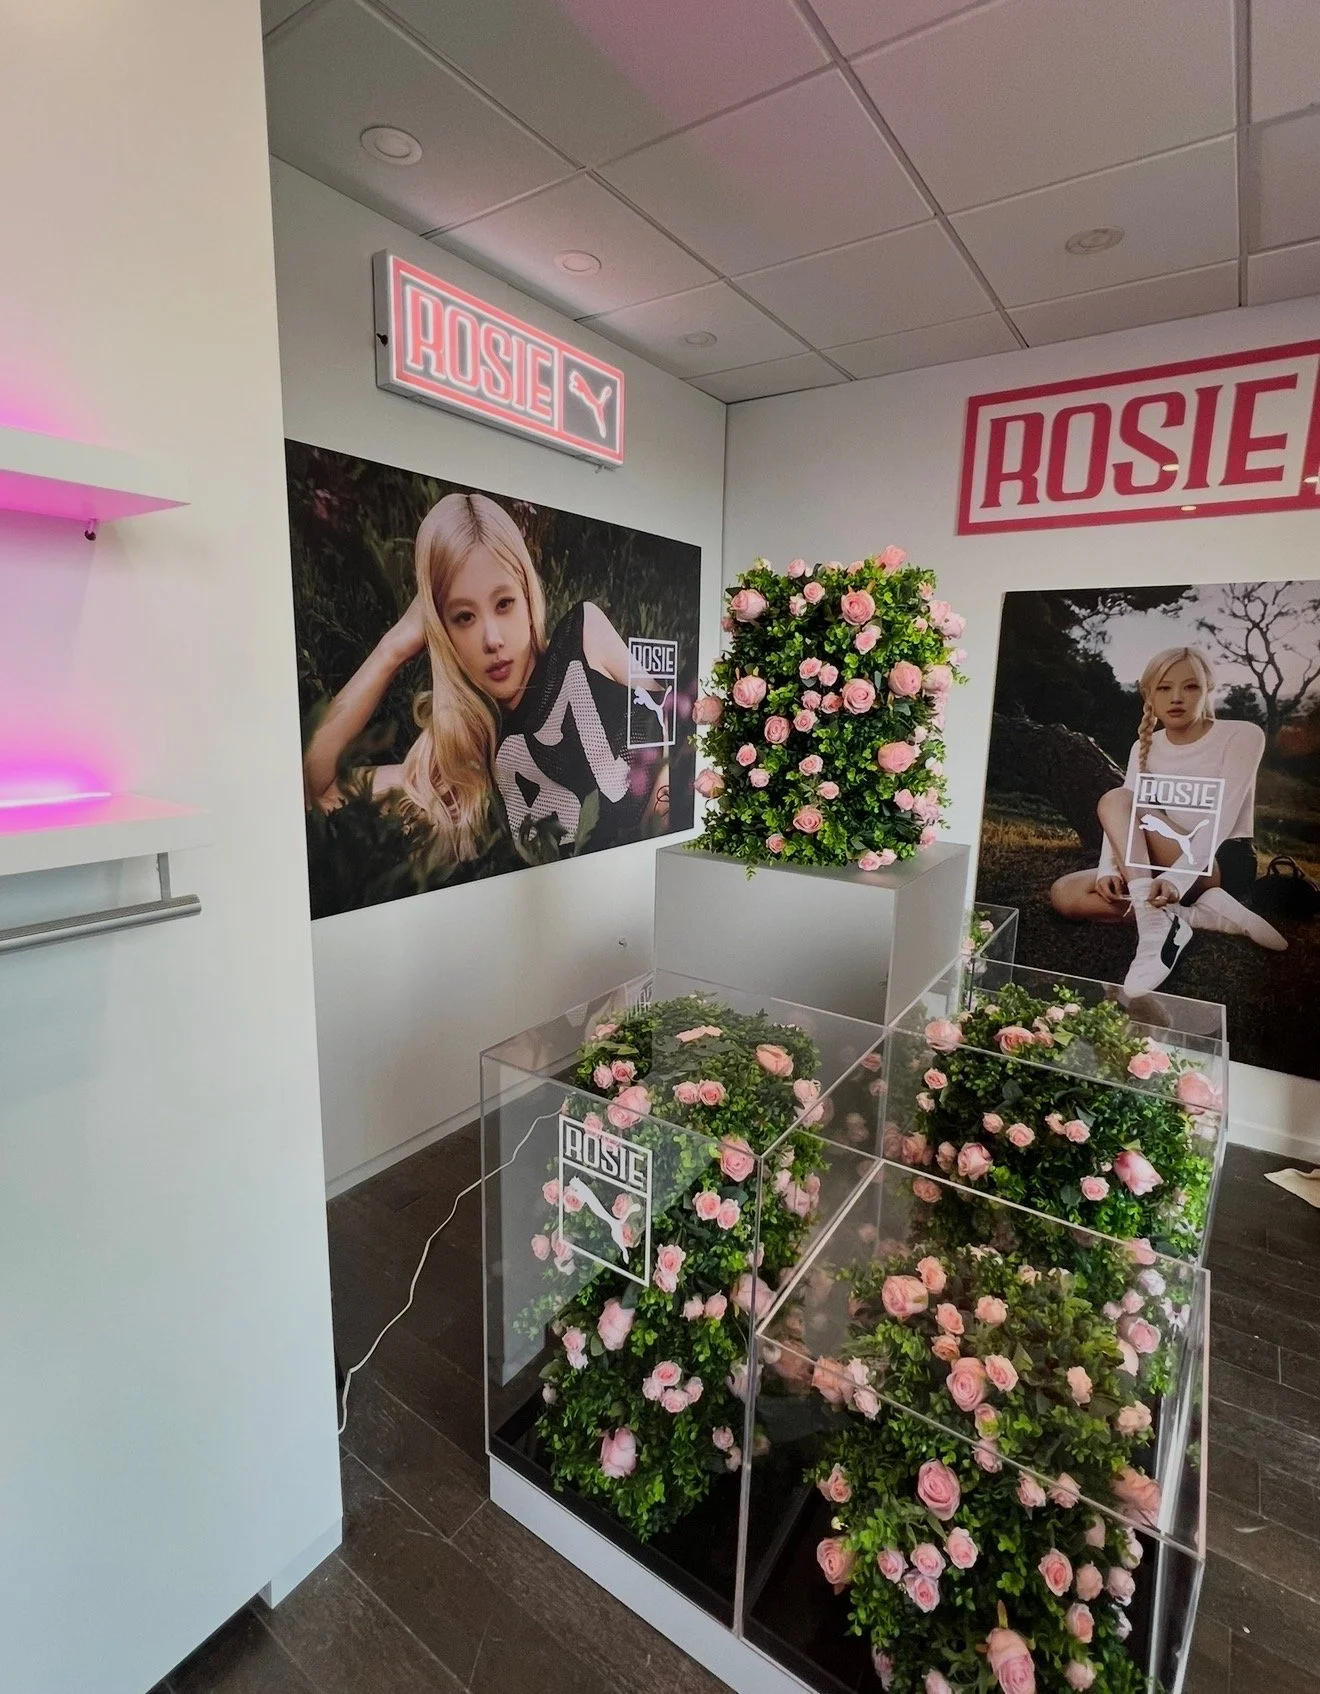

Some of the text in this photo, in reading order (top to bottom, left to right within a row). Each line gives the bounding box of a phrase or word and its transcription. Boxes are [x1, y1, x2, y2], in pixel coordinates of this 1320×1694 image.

[405, 285, 553, 421] ROSIE
[979, 373, 1299, 509] ROSIE
[632, 644, 675, 673] ROSIE
[1139, 779, 1217, 807] ROSIE
[565, 1125, 645, 1189] ROSIE
